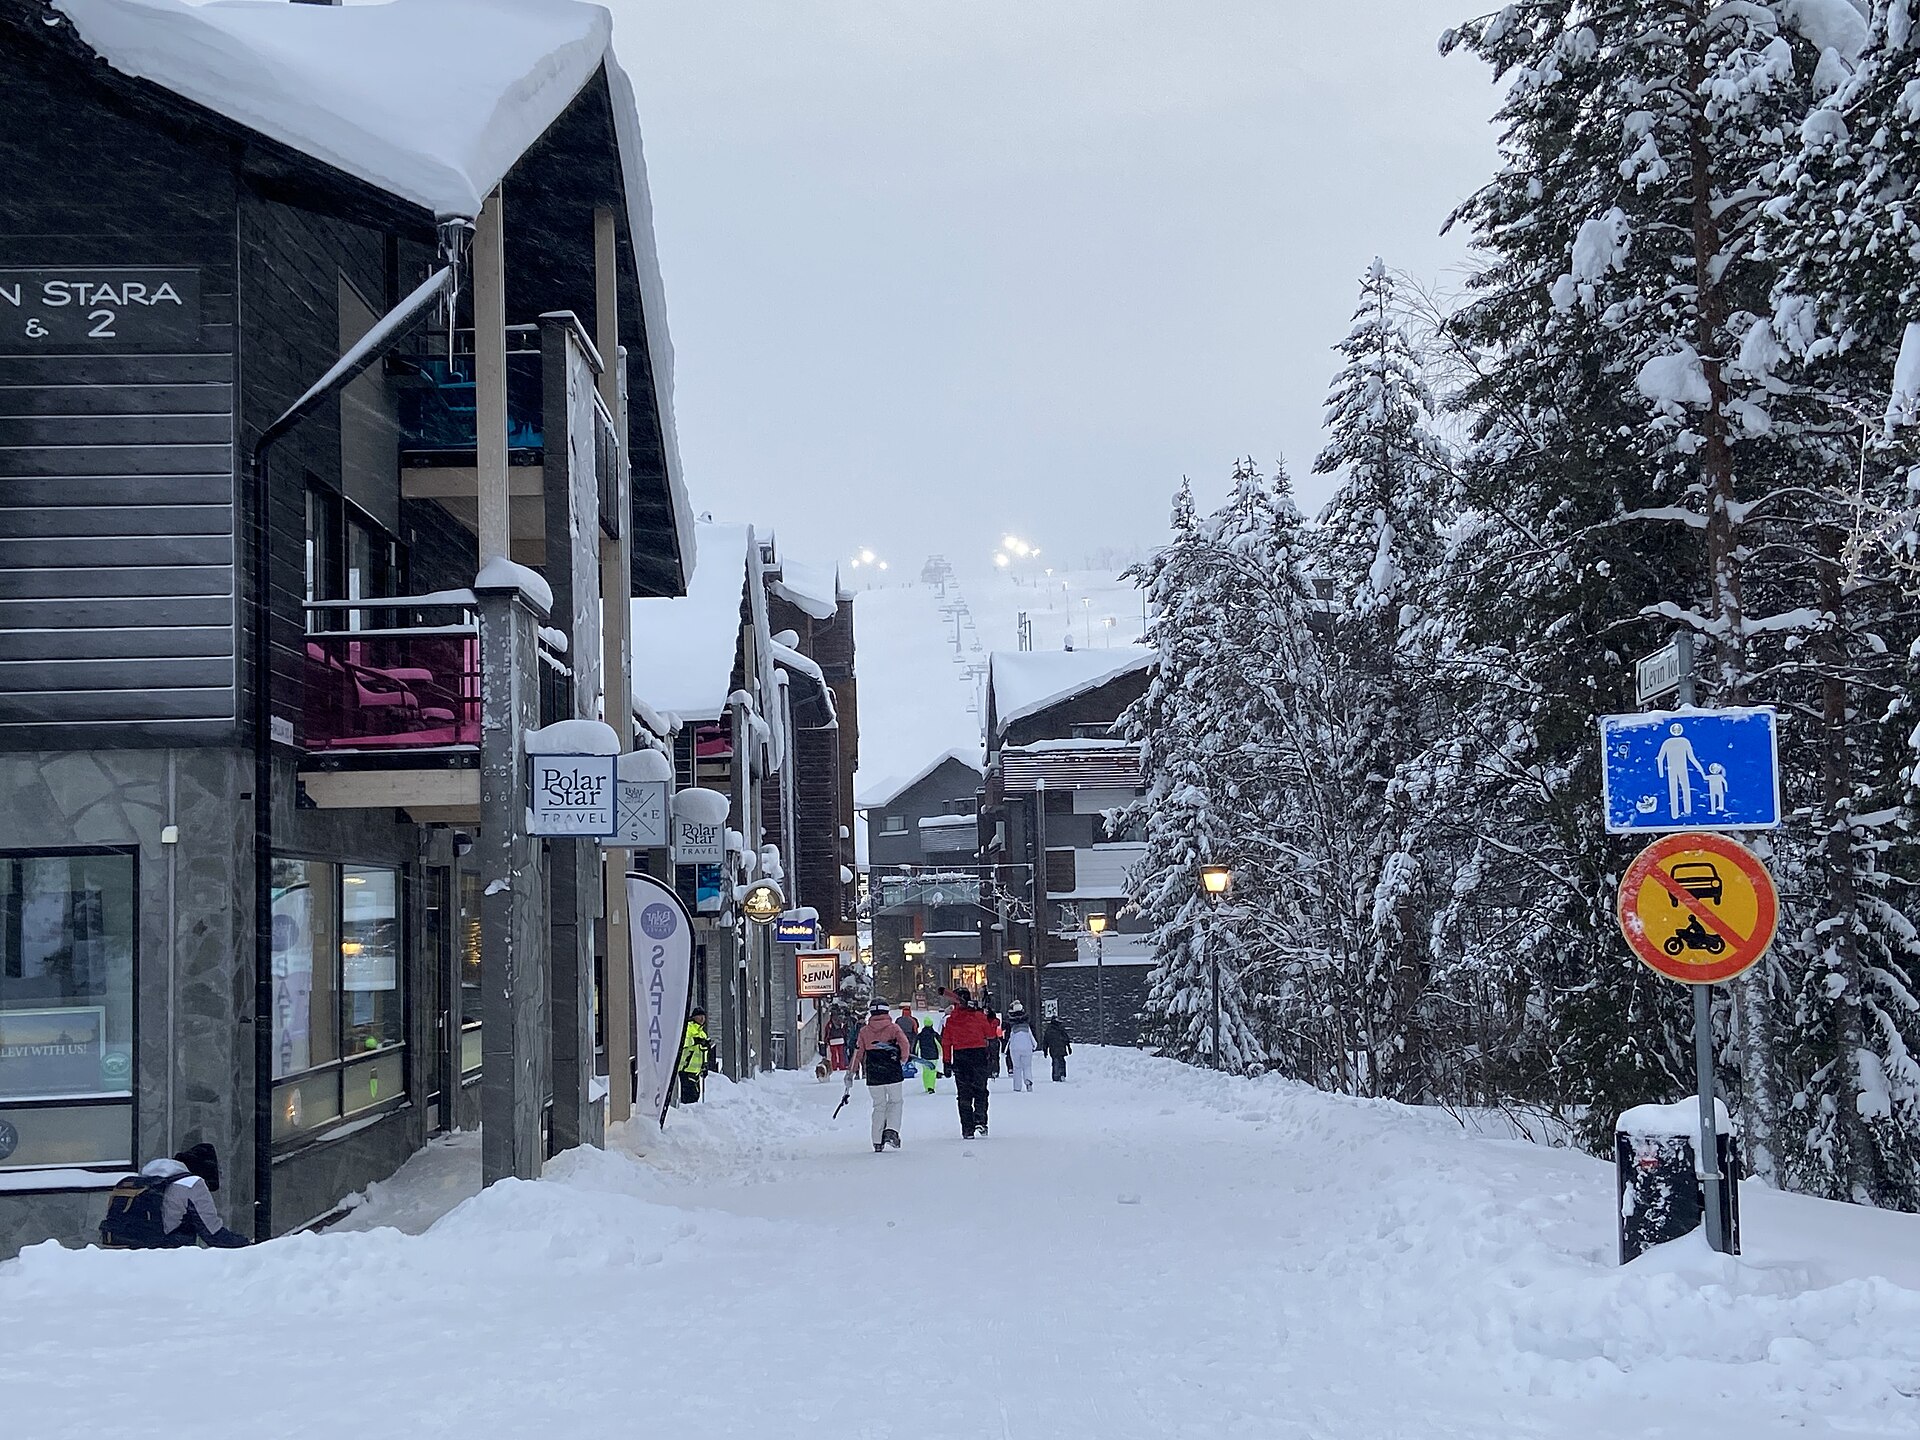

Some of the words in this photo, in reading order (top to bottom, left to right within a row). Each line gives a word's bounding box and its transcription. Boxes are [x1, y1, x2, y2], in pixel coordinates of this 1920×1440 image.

[42, 280, 183, 306] STARA
[25, 318, 49, 338] &
[87, 309, 116, 338] 2
[1644, 665, 1665, 690] Levin
[541, 768, 607, 790] Polar
[548, 783, 601, 806] Star
[541, 813, 607, 823] TRAVEL
[682, 823, 718, 836] Polar
[685, 832, 715, 844] Star
[1, 1046, 28, 1057] LEVI
[31, 1045, 65, 1056] WITH
[68, 1043, 87, 1055] US!
